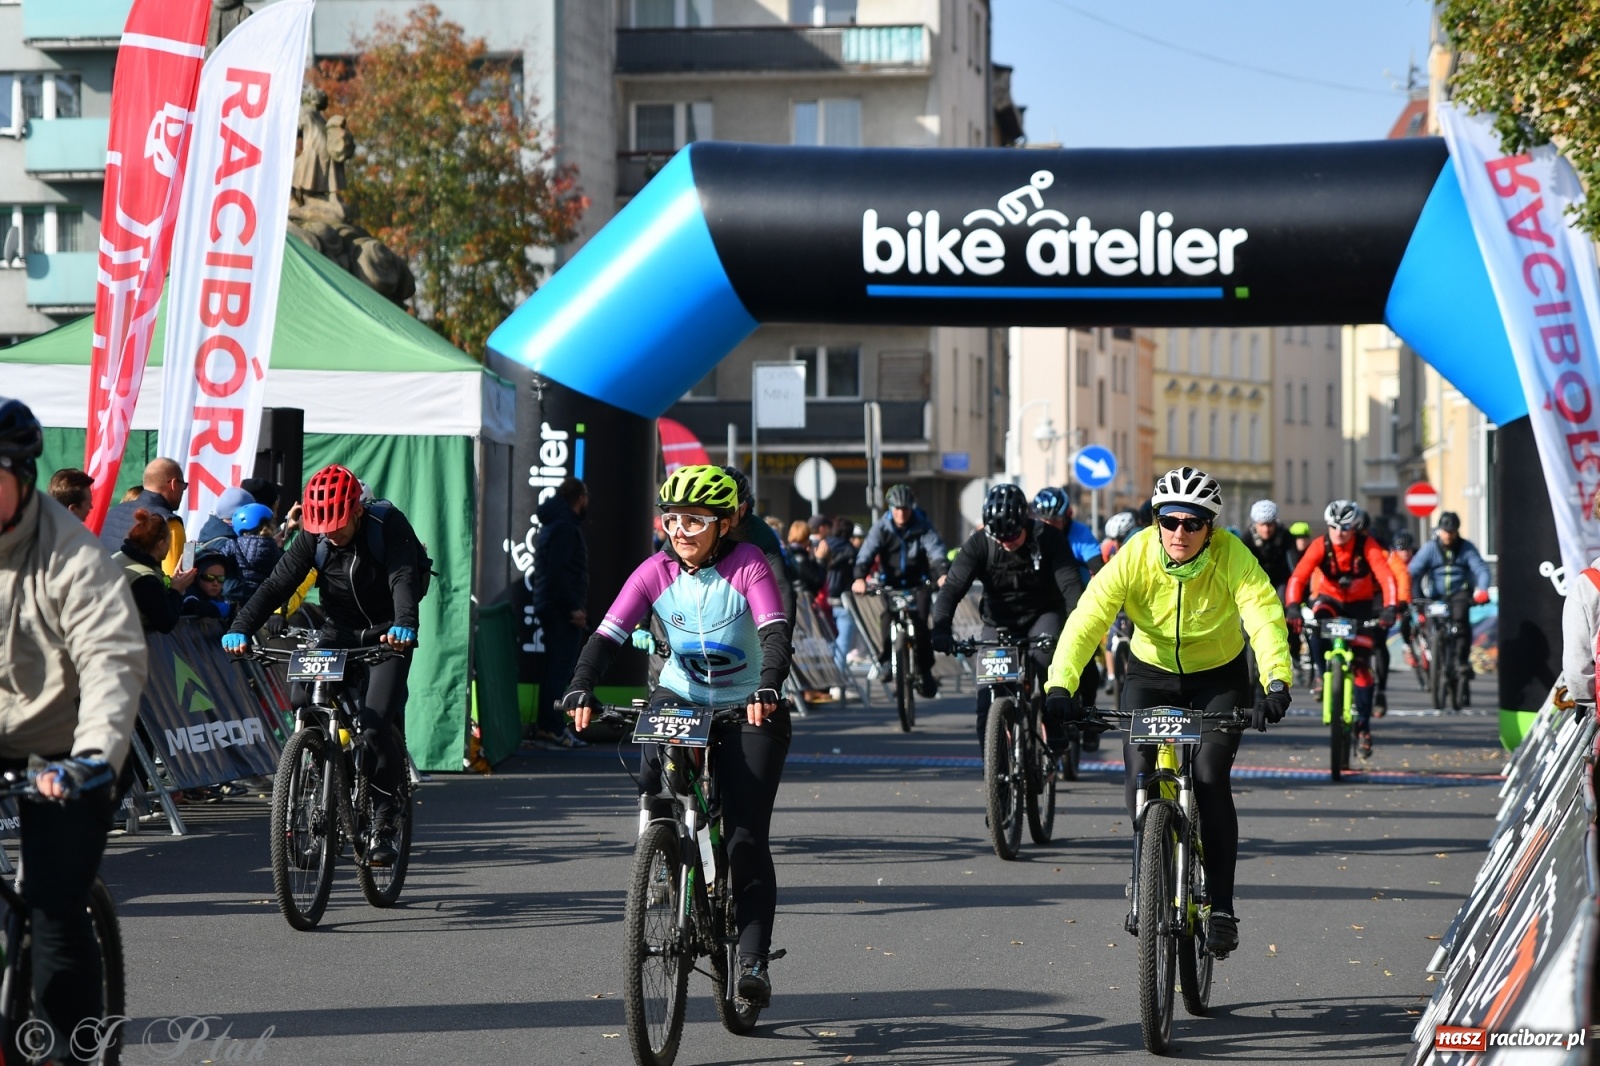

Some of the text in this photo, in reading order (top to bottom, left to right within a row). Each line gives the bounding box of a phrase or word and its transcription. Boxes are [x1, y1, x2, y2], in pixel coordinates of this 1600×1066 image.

[862, 208, 1249, 275] bike atelier
[188, 67, 272, 511] RACIBÓRZ
[301, 662, 330, 674] 301
[985, 663, 1009, 675] 240
[648, 716, 701, 726] OPIEKUN
[1142, 716, 1191, 724] OPIEKUN
[653, 723, 691, 738] 152
[1147, 723, 1183, 736] 122
